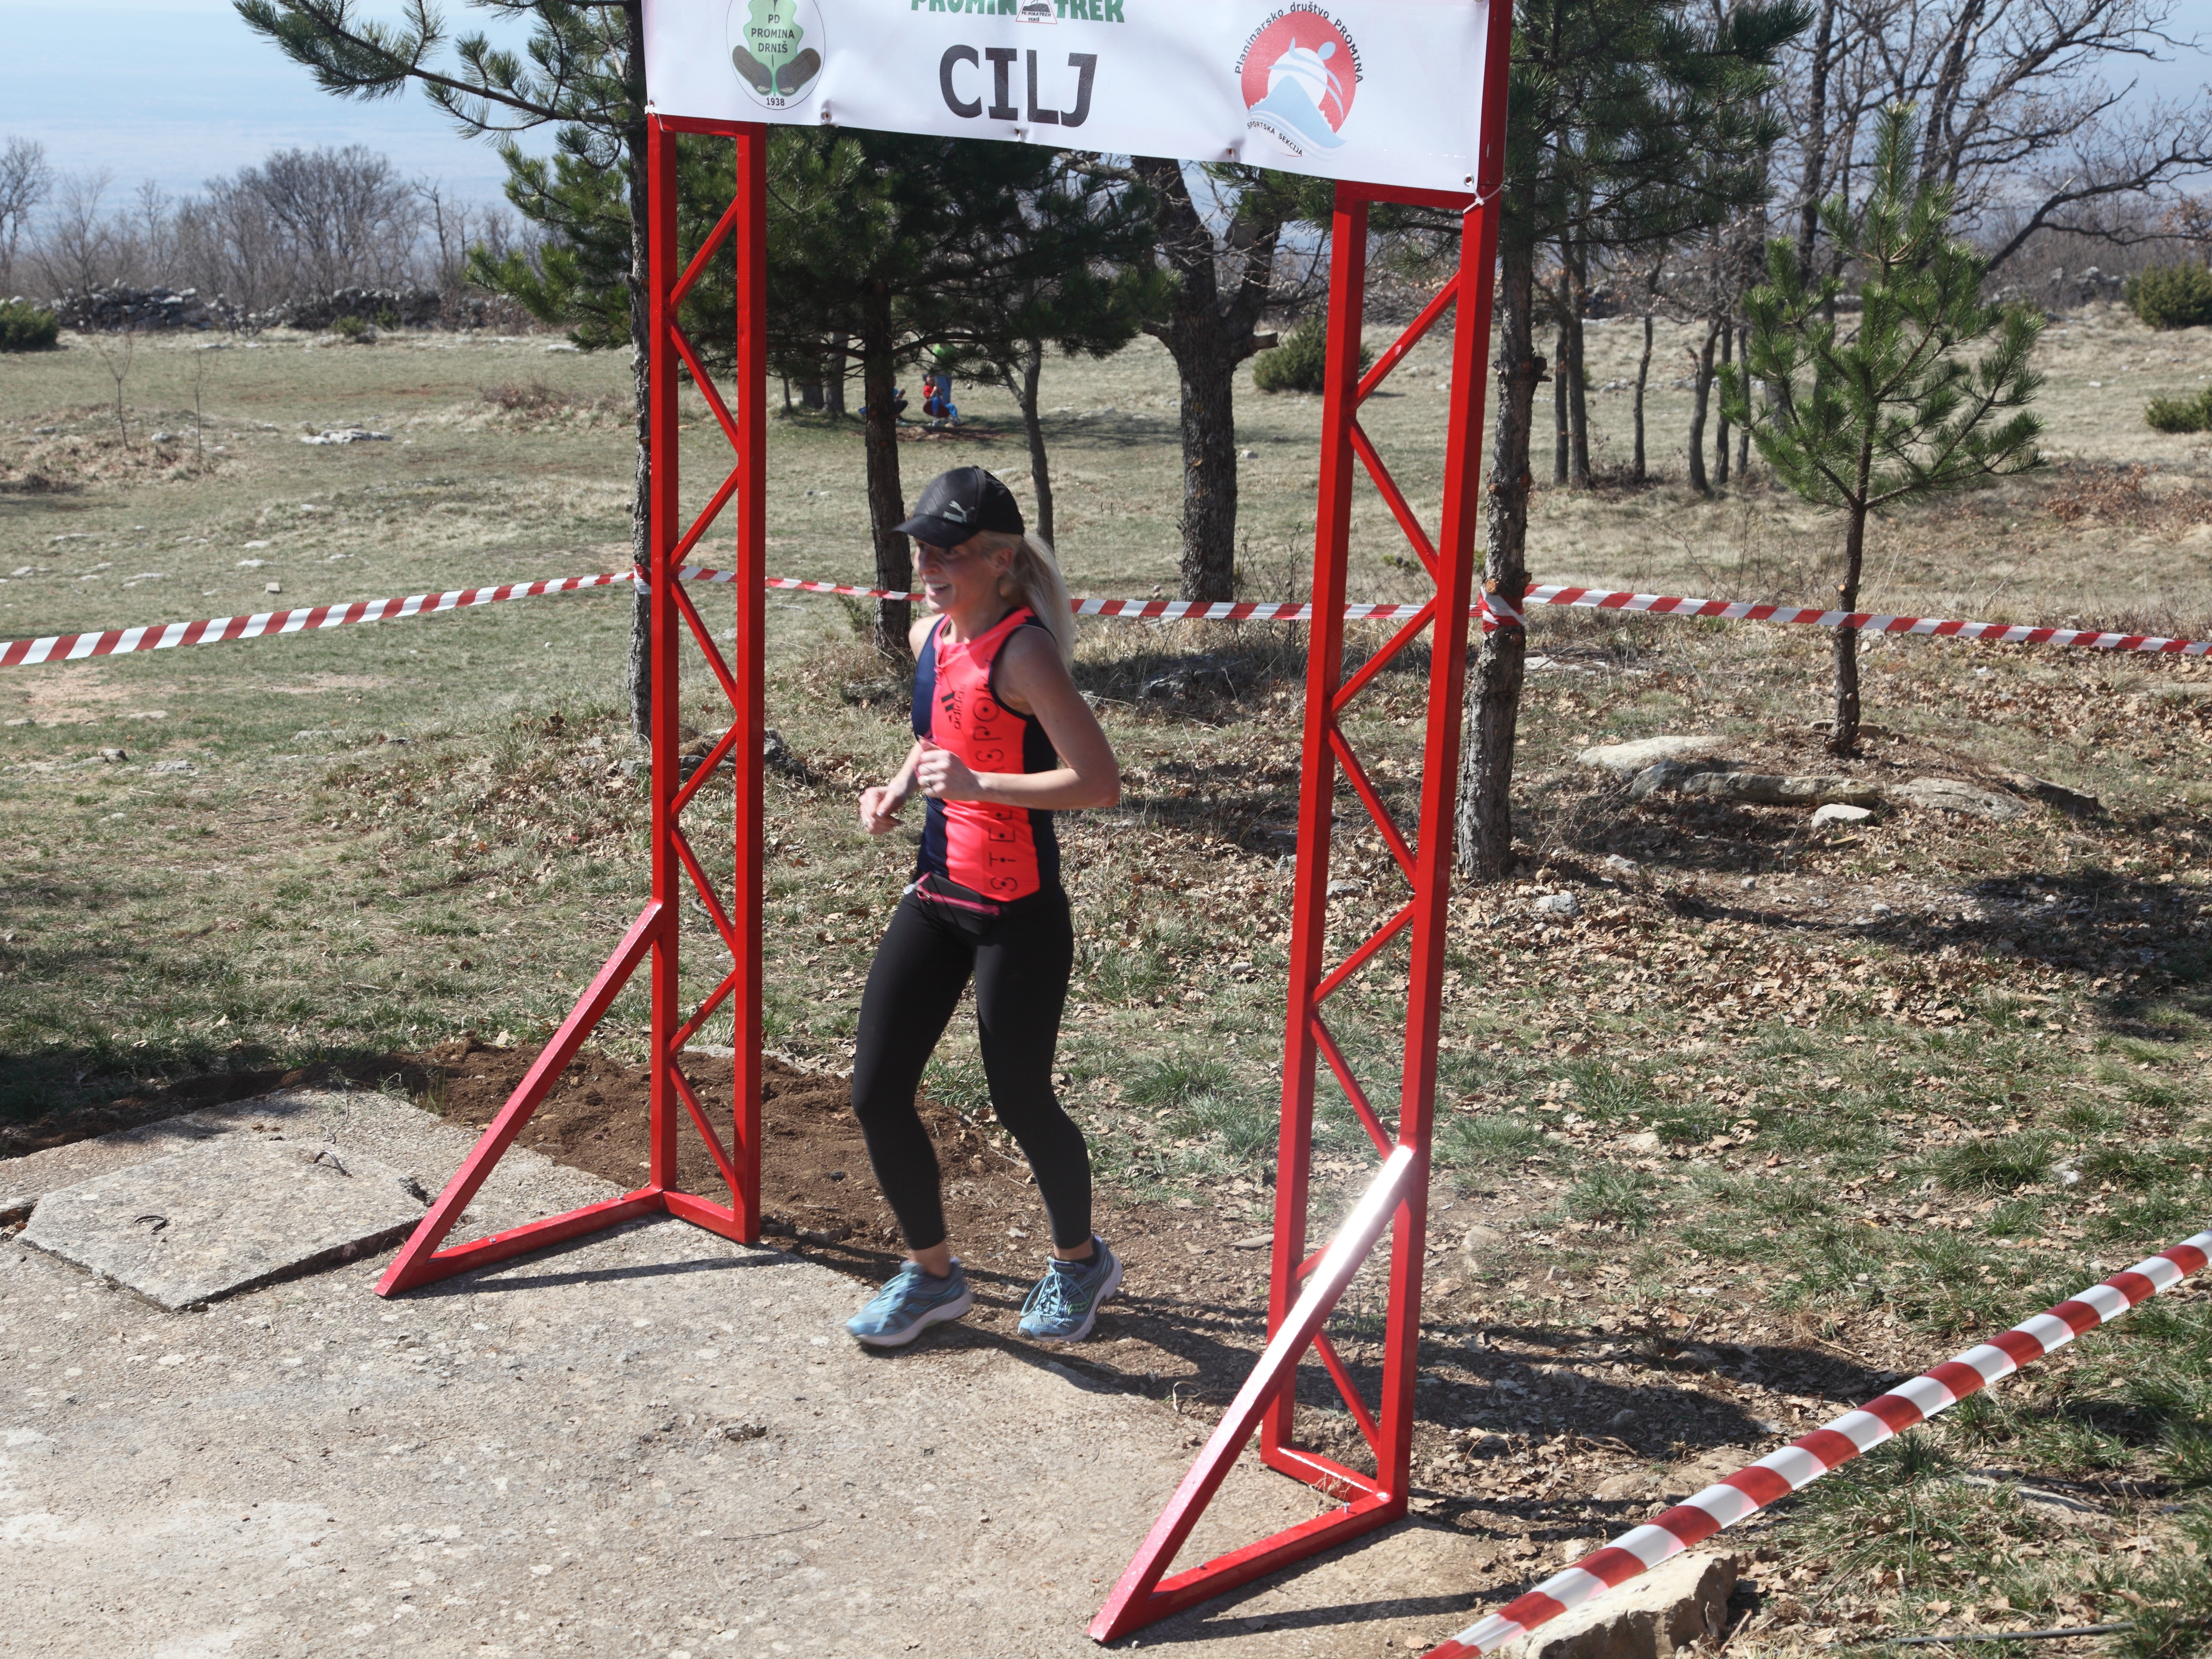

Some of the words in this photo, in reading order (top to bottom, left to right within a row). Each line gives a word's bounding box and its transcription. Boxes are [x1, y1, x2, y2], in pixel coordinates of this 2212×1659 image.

[768, 14, 780, 23] PD
[1054, 0, 1125, 23] TREK
[751, 27, 794, 39] PROMINA
[1235, 9, 1284, 74] Planinarsko
[1290, 1, 1329, 19] društvo
[1334, 18, 1363, 83] PROMINA
[758, 40, 788, 53] DRNIŠ
[939, 44, 1098, 128] CILJ
[766, 97, 785, 107] 1938
[1247, 121, 1275, 135] SPORTSKA
[1278, 132, 1302, 156] SEKCIJA
